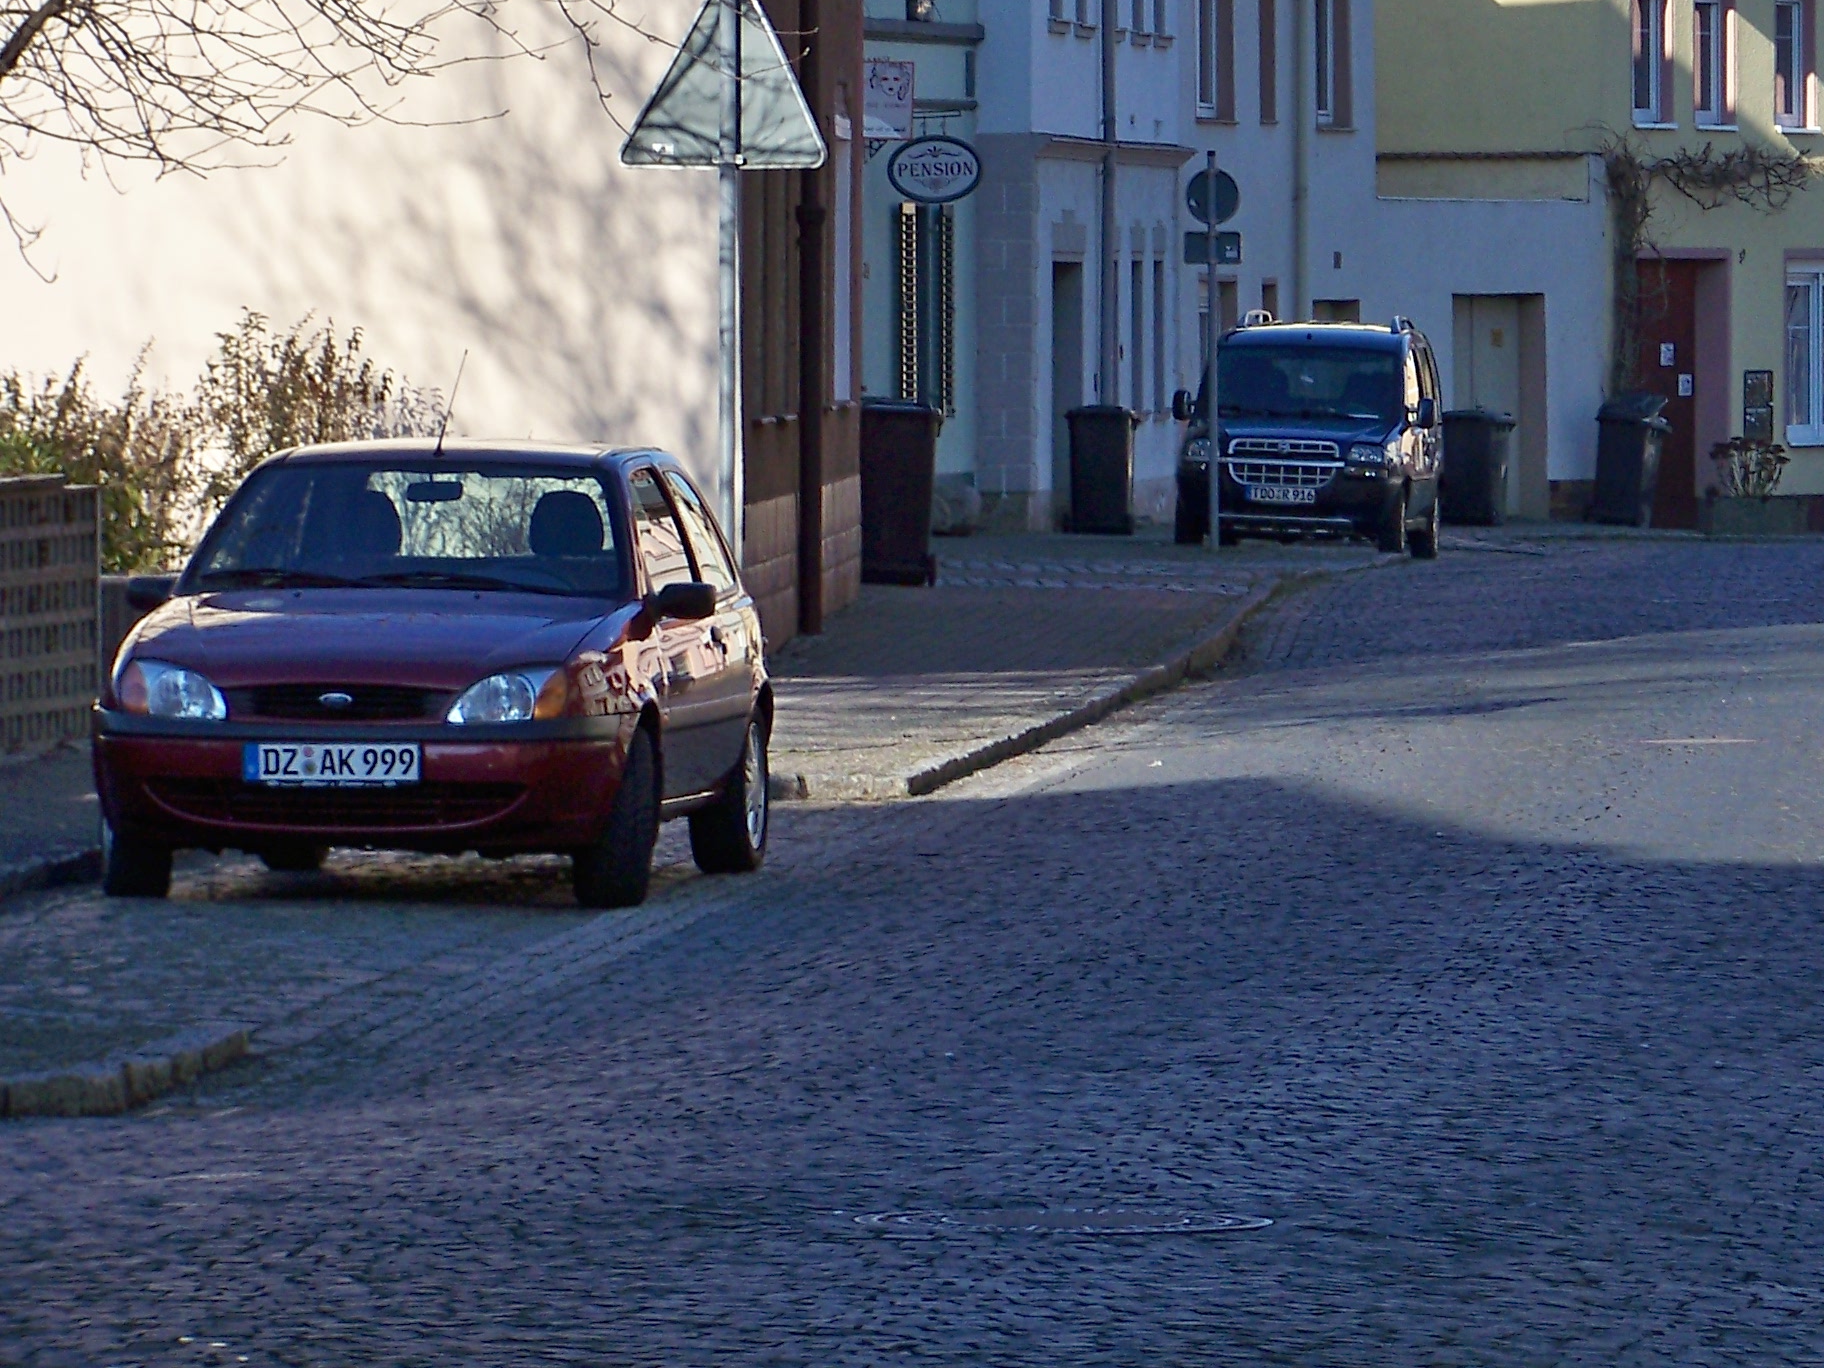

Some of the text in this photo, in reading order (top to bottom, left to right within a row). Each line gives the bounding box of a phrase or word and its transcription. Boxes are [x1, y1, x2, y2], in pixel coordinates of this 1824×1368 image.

[898, 161, 974, 178] PENSION
[263, 748, 415, 775] DZ AK 999
